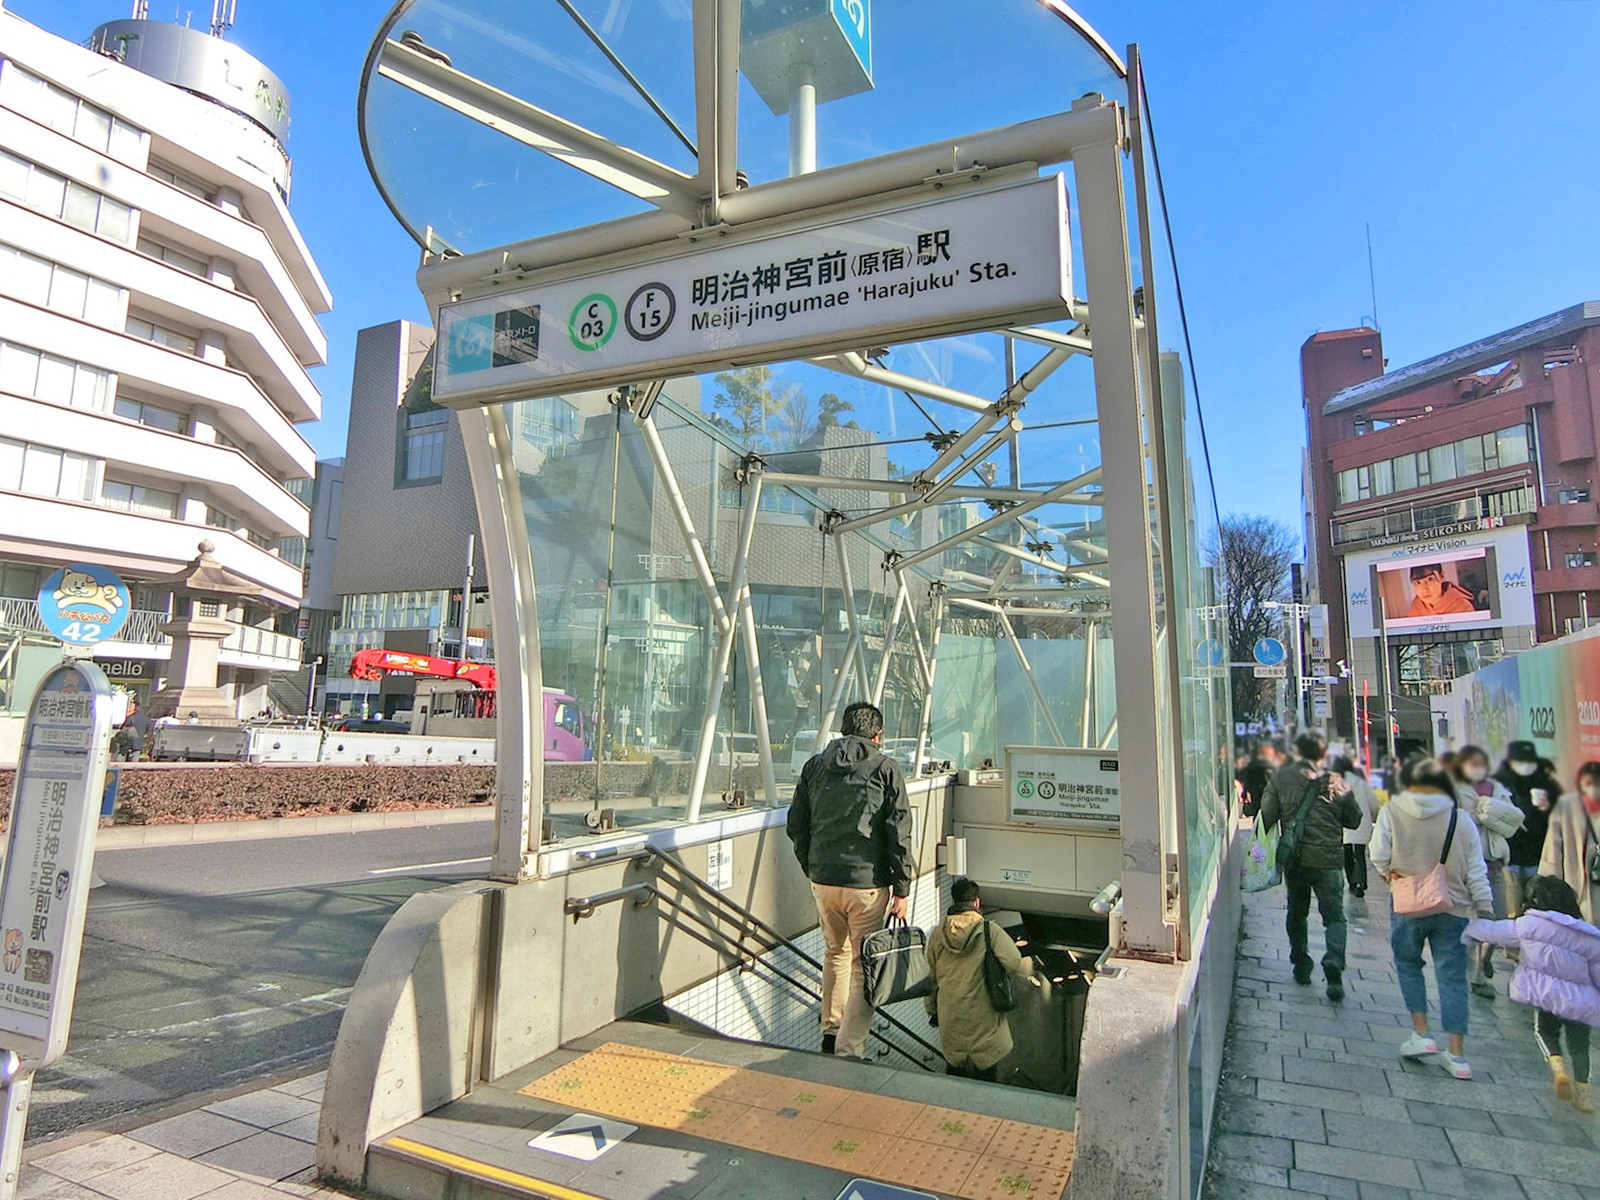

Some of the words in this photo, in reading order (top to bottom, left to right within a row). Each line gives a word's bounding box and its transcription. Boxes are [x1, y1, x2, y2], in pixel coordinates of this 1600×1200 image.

[692, 229, 951, 307] 明治神宮前〈原宿〉駅
[646, 292, 655, 308] F
[691, 290, 849, 331] Meiji-jingumae
[858, 269, 960, 302] 'Harajuku'
[969, 261, 1017, 284] Sta.
[588, 303, 598, 319] C
[640, 309, 661, 329] 15
[580, 320, 604, 340] 03
[1407, 542, 1435, 554] マイナビ
[1436, 538, 1467, 551] Vision
[1503, 580, 1527, 588] マイナビ
[58, 609, 111, 625] ハチ公バス
[62, 622, 101, 642] 42
[1529, 706, 1556, 738] 2023
[30, 781, 68, 942] 明治神宮前駅
